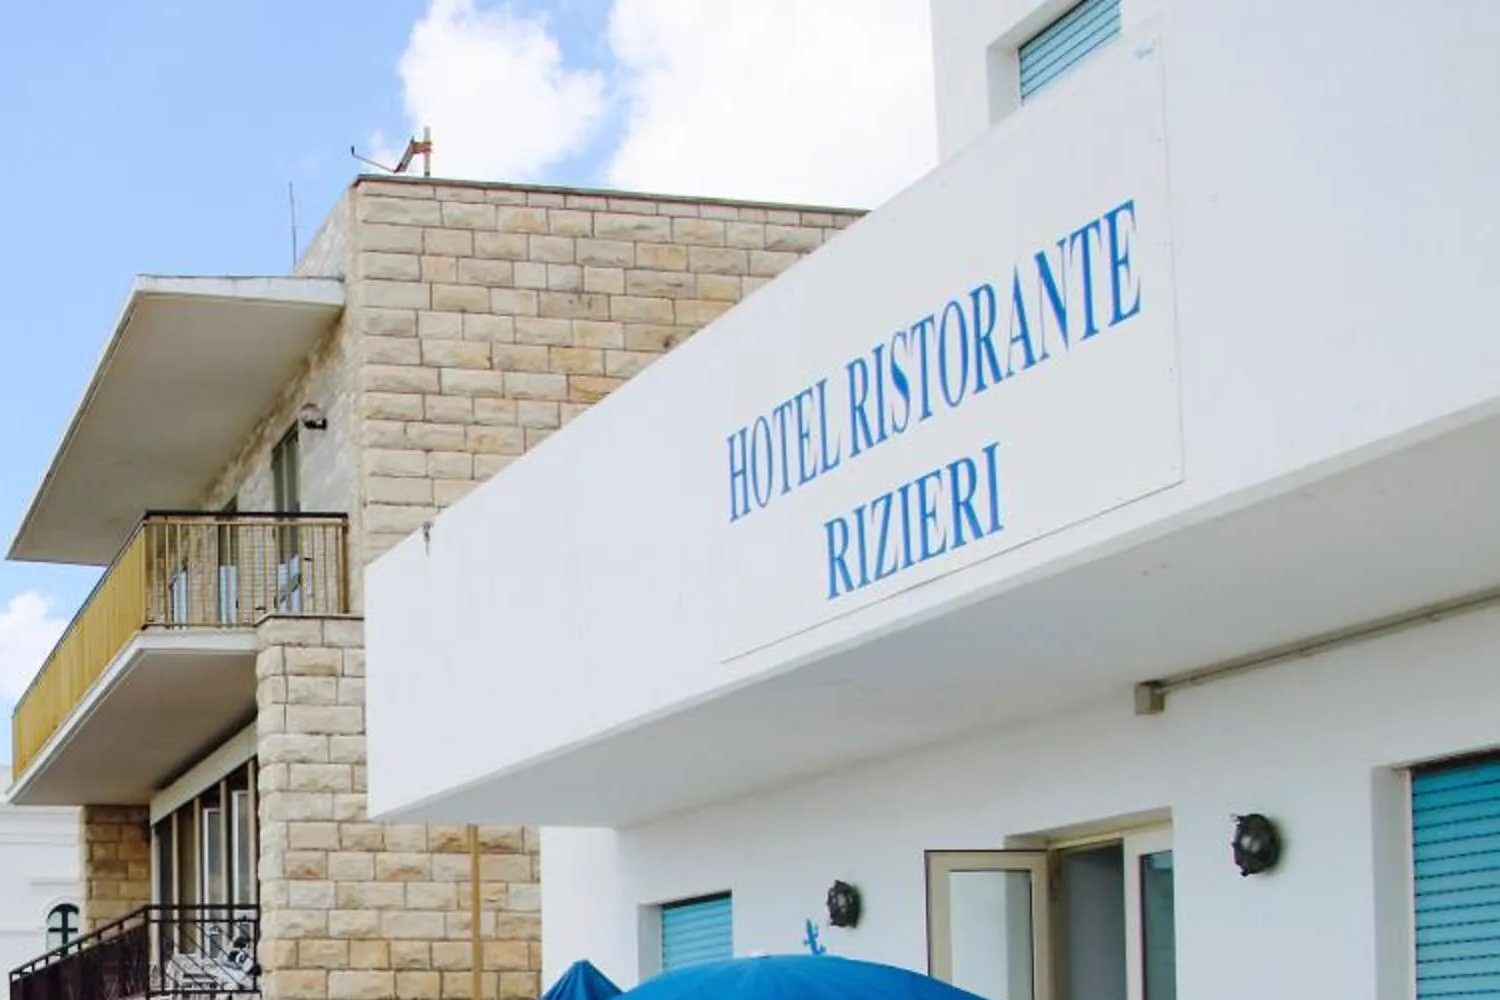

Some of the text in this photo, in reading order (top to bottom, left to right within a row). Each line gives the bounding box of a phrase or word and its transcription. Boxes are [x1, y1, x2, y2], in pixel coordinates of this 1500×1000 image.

[725, 198, 1142, 524] HOTEL RISTORANTE
[823, 442, 1005, 600] RIZIERI
